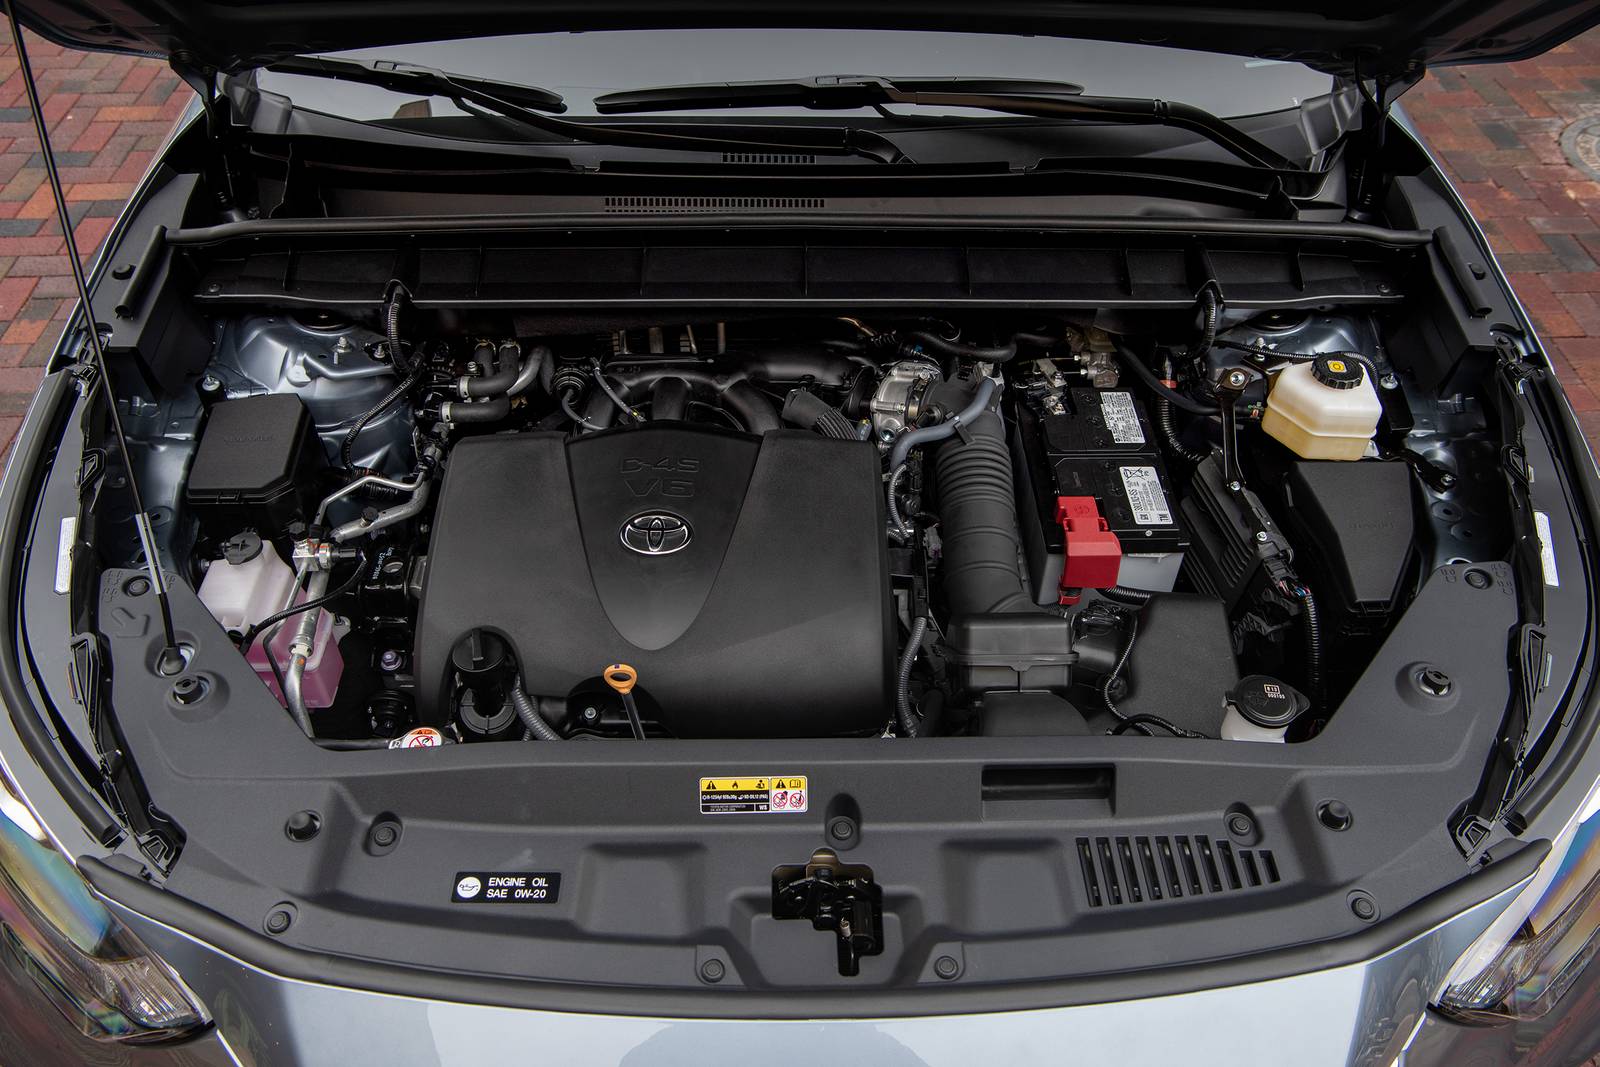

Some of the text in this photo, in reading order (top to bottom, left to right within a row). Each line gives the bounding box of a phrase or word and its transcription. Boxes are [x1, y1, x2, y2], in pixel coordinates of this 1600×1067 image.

[621, 456, 700, 473] D-4S
[623, 478, 694, 497] V6
[488, 877, 548, 887] ENGINE OIL
[486, 888, 547, 898] SAE 0W-20
